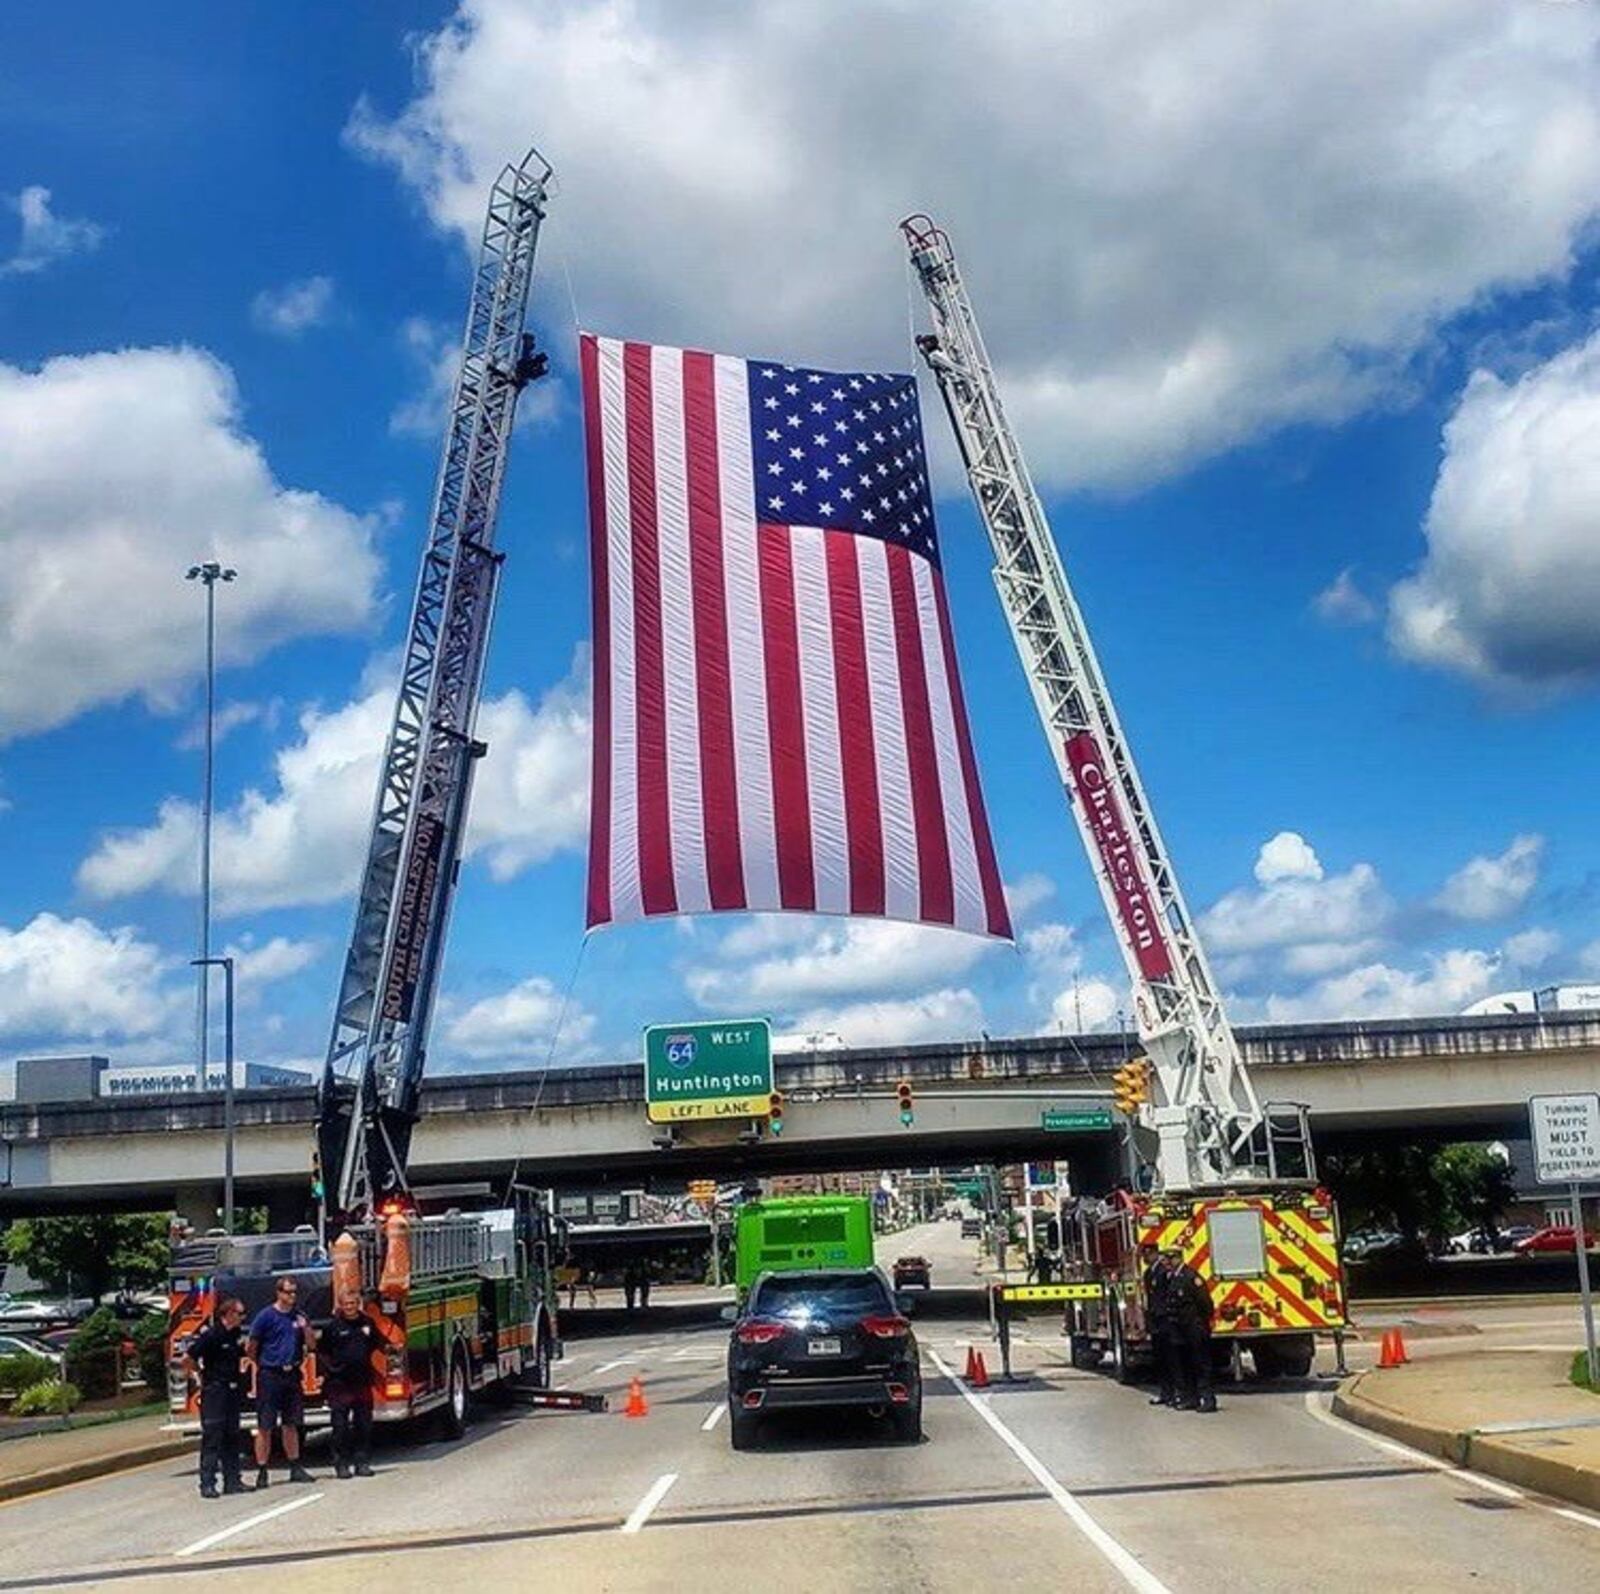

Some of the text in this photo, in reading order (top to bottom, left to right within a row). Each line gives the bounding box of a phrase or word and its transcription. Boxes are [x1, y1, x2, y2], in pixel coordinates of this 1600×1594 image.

[1080, 763, 1154, 949] Charleston
[383, 817, 436, 1019] SOUTH CHARLESTON
[711, 1031, 751, 1045] WEST
[669, 1043, 692, 1061] 64
[656, 1073, 763, 1092] Huntington
[670, 1102, 751, 1117] LEFT LANE
[1544, 1105, 1587, 1115] TURNING
[1546, 1117, 1588, 1127] TRAFFIC
[1550, 1131, 1587, 1143] MUST
[1549, 1146, 1594, 1157] YIELD TO
